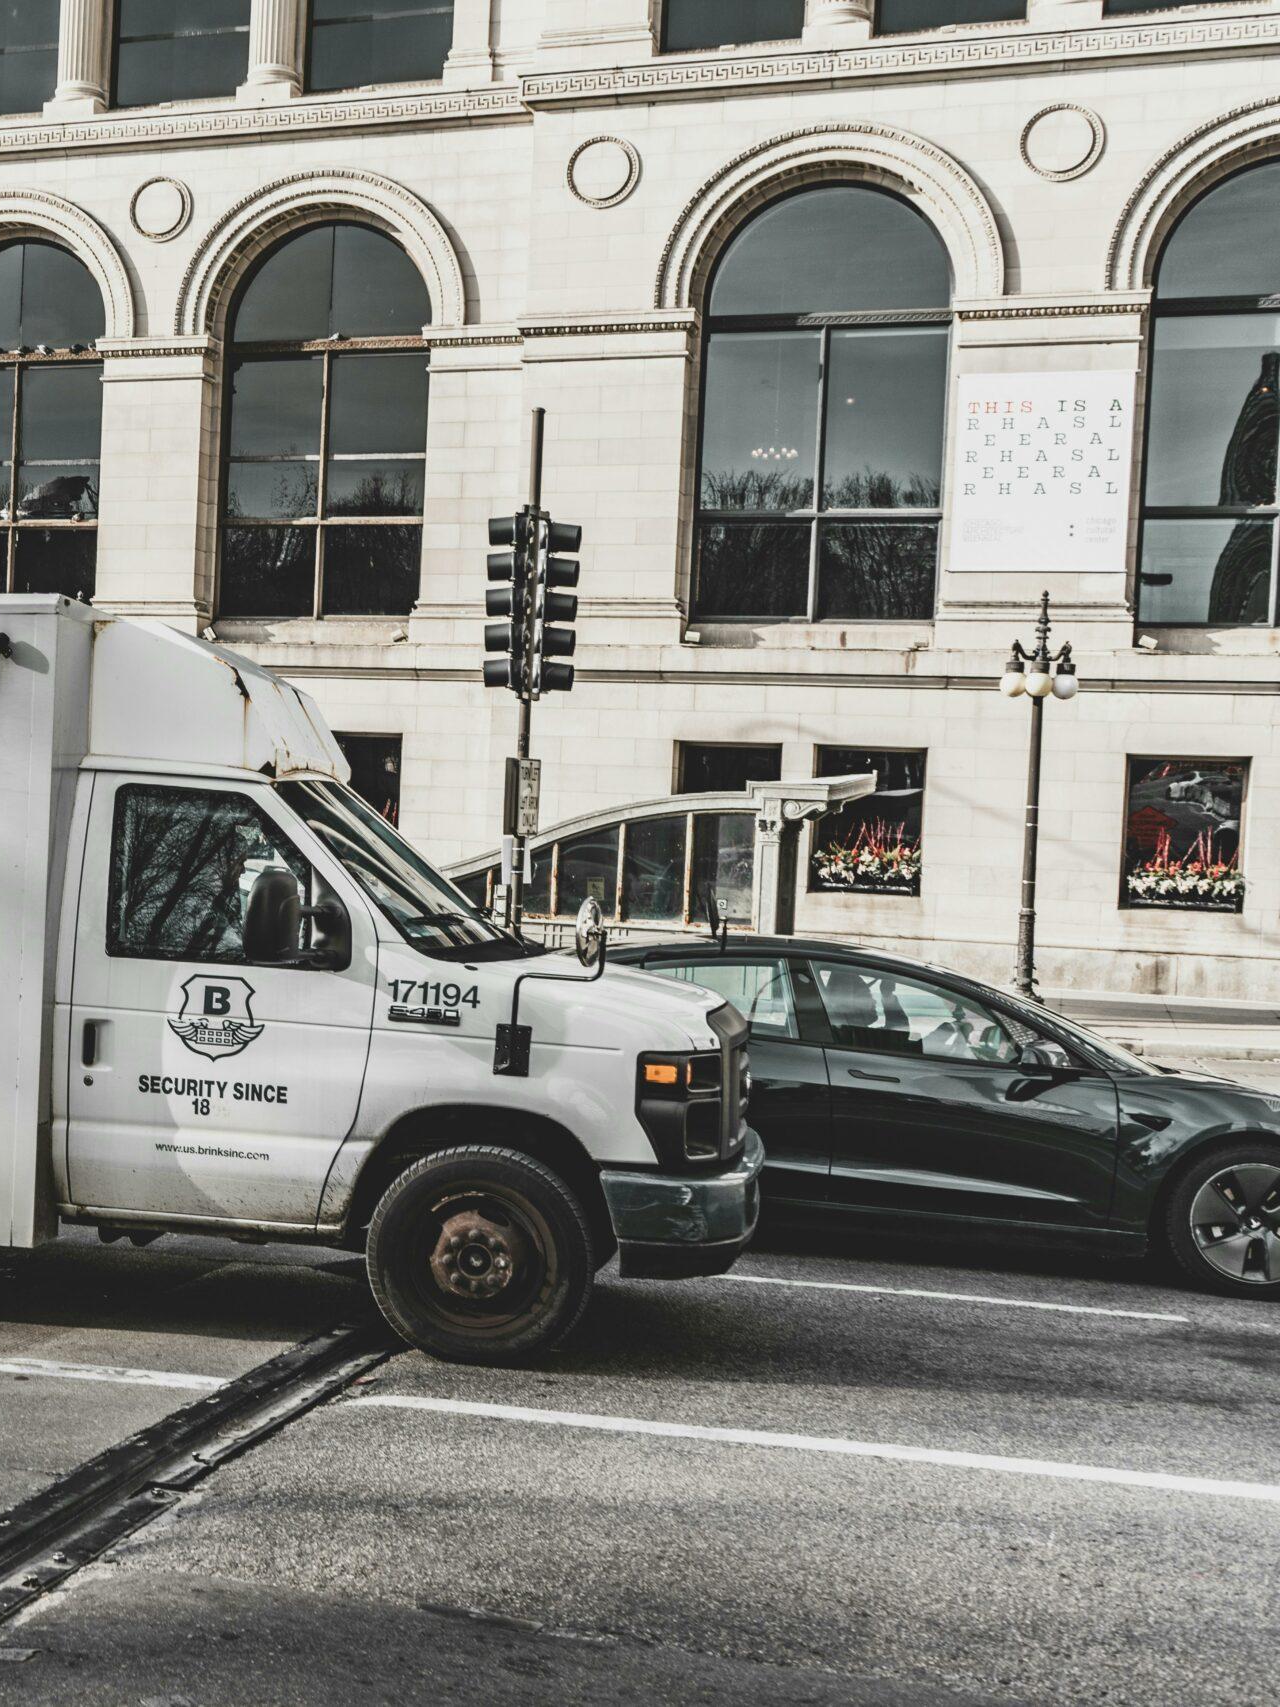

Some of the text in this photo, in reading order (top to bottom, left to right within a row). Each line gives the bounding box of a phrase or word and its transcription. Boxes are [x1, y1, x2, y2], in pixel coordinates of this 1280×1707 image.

[968, 399, 1123, 414] THIS IS A
[202, 985, 232, 1016] B
[387, 979, 481, 1009] 171194
[138, 1074, 288, 1104] SECURITY SINCE
